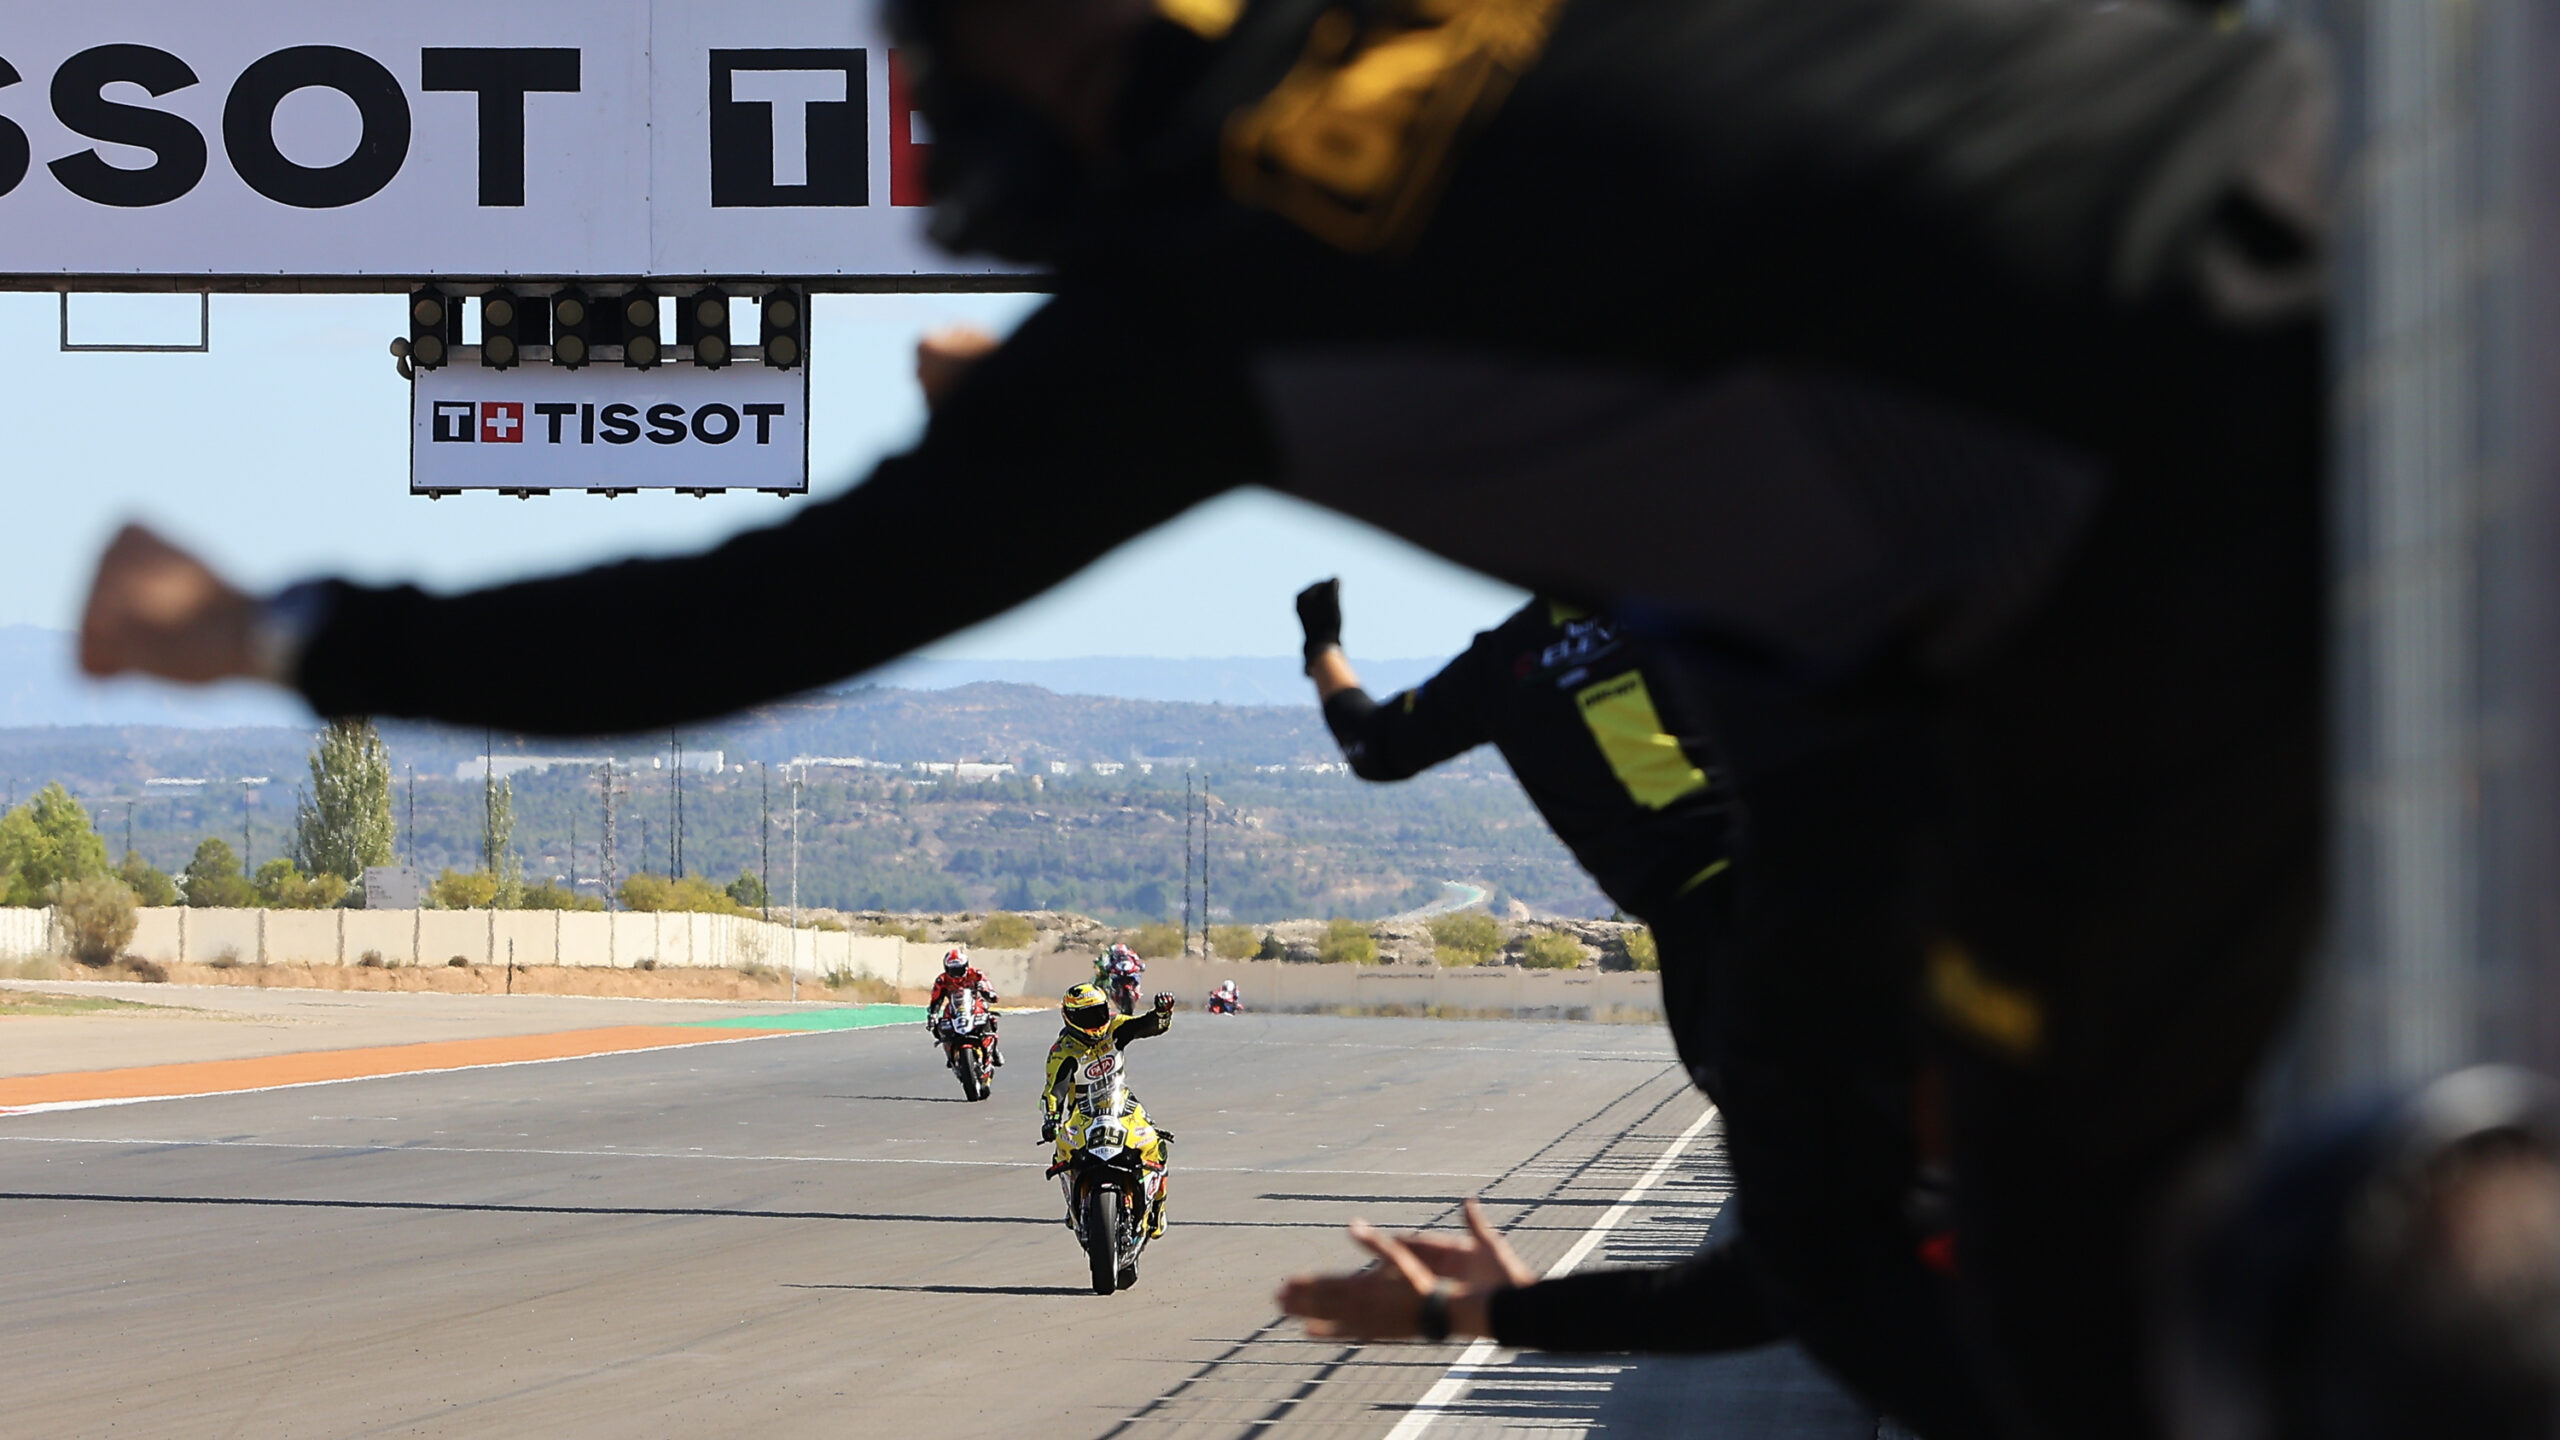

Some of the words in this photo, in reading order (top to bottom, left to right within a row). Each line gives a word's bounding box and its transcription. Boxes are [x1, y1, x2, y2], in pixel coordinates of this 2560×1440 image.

[0, 42, 582, 208] SOT
[533, 402, 786, 445] TISSOT
[1087, 1125, 1126, 1149] 29
